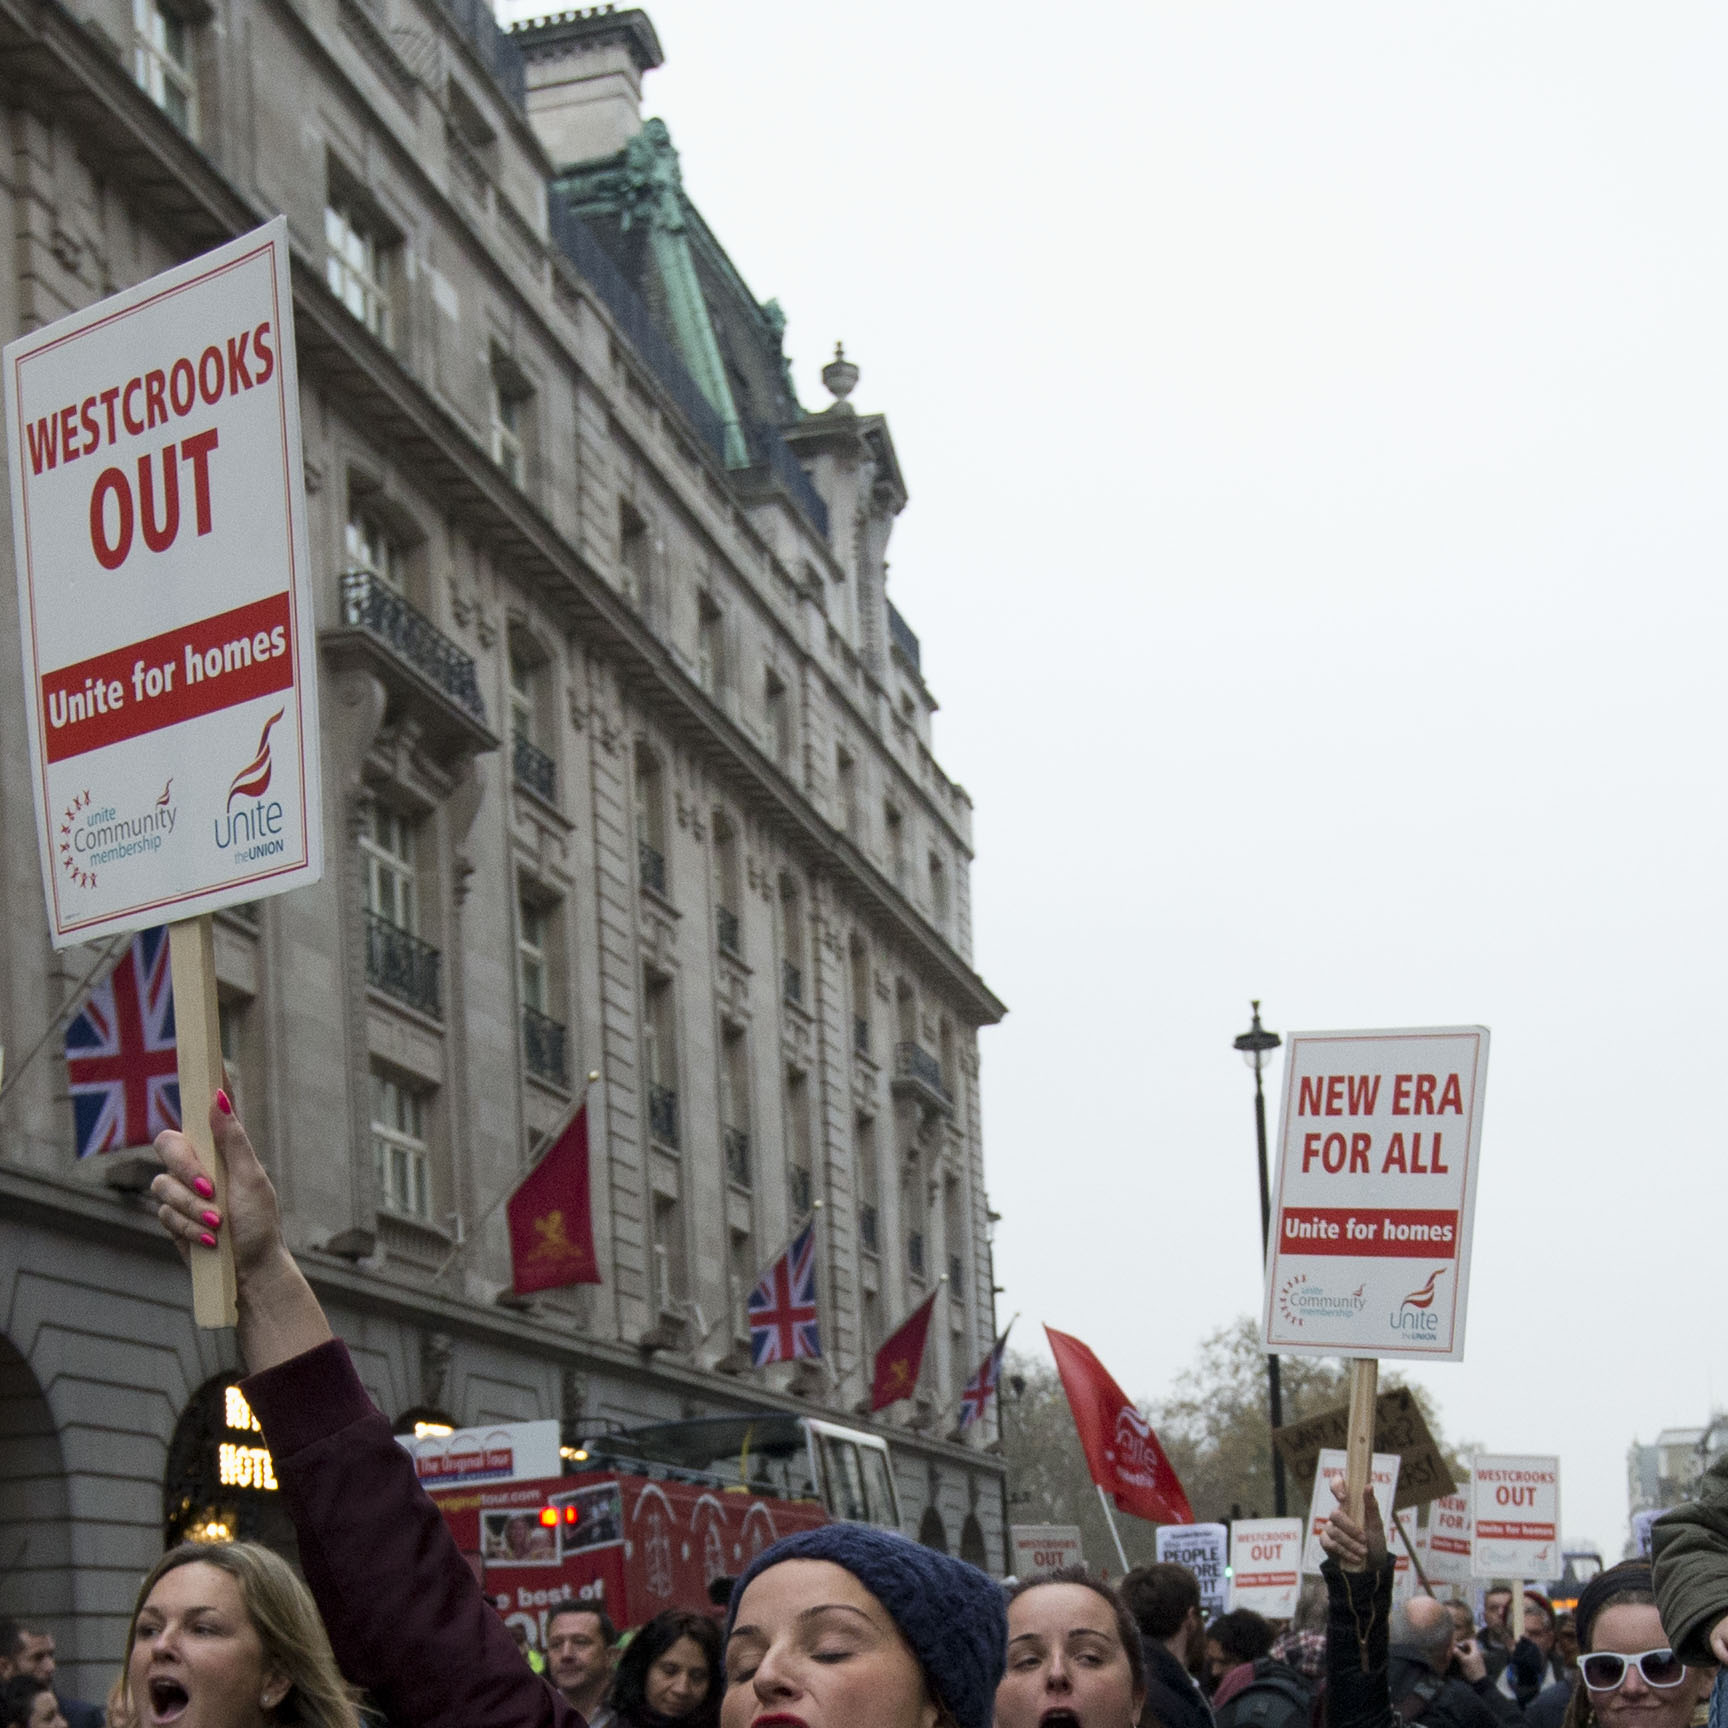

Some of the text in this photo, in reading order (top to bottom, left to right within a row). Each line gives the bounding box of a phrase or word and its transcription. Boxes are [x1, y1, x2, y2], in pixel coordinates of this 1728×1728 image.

[26, 321, 274, 476] WESTCROOKS
[90, 427, 218, 570] OUT
[48, 625, 286, 728] Unite for homes
[87, 806, 116, 828] unite
[214, 801, 283, 849] unite
[74, 807, 177, 853] Community
[90, 833, 162, 868] membership
[1298, 1072, 1464, 1117] NEW ERA
[1301, 1132, 1449, 1175] FOR ALL
[1285, 1216, 1453, 1241] Unite for homes
[1290, 1293, 1366, 1311] Community
[1390, 1310, 1438, 1331] unite
[1477, 1469, 1555, 1484] WESTCROOKS
[1438, 1496, 1466, 1512] NEW
[1495, 1485, 1537, 1506] OUT
[1439, 1514, 1463, 1529] FOR
[1237, 1531, 1298, 1543] WESTCROOKS
[1033, 1551, 1065, 1567] OUT
[1164, 1547, 1219, 1563] PEOPLE
[1250, 1545, 1283, 1561] OUT
[517, 1583, 571, 1607] best
[579, 1578, 604, 1600] of
